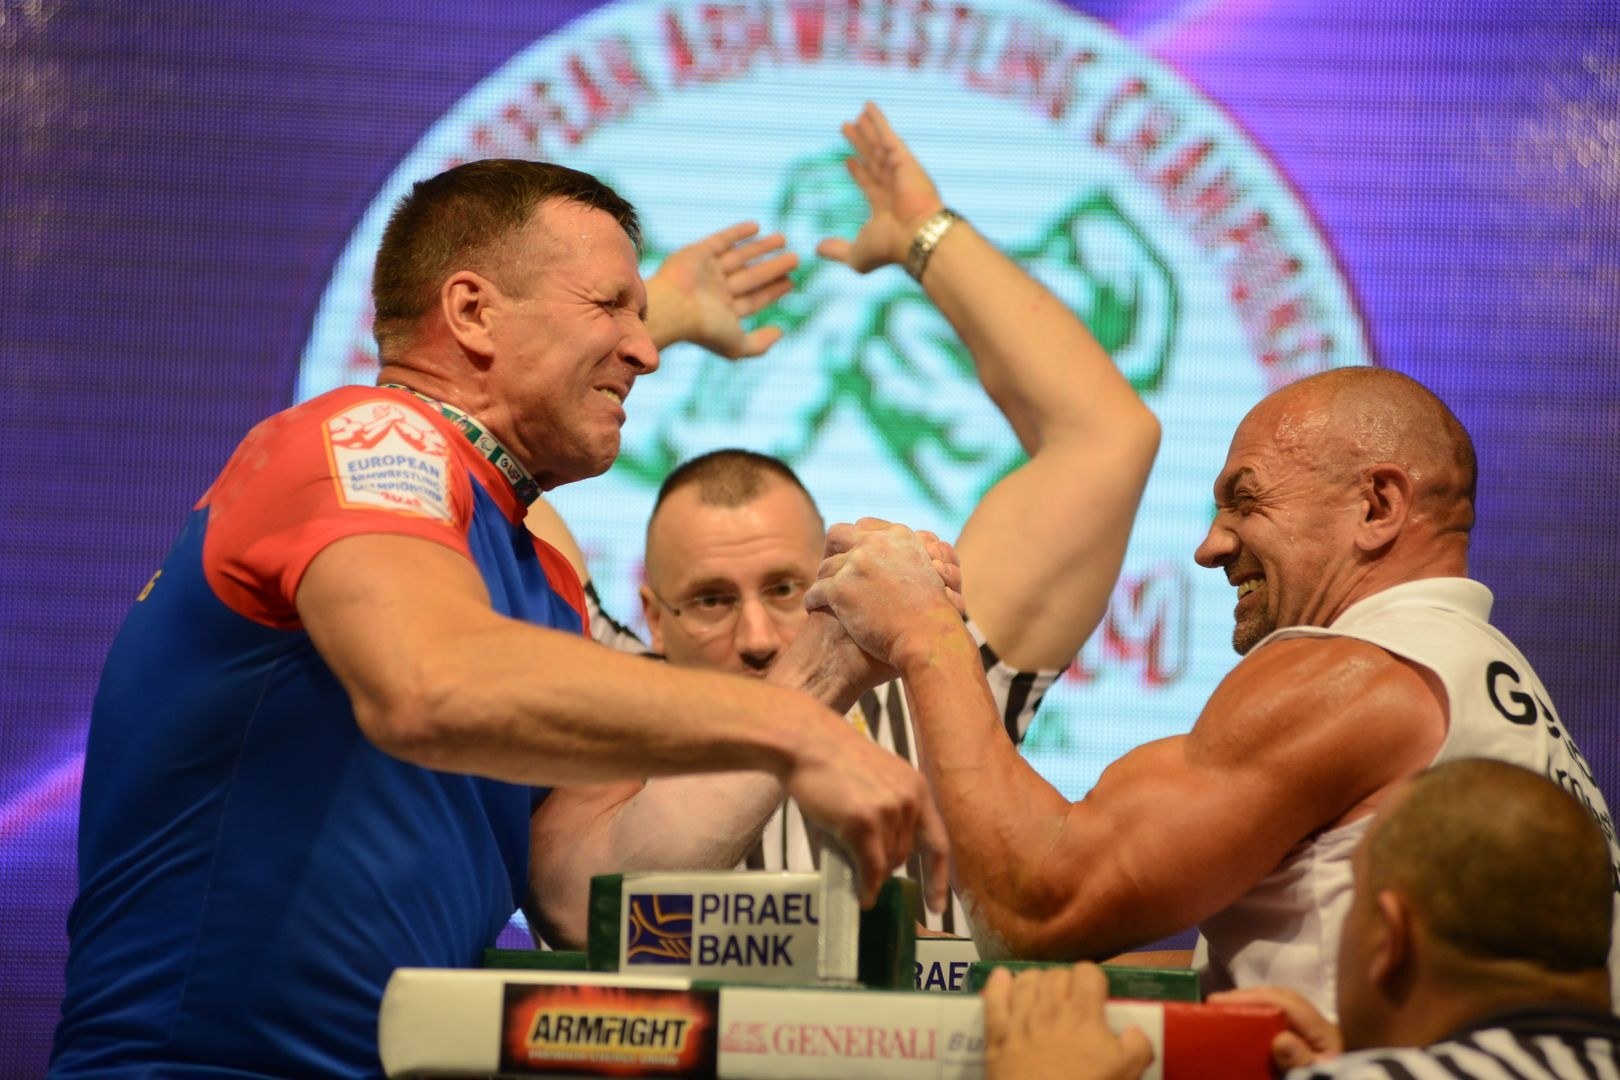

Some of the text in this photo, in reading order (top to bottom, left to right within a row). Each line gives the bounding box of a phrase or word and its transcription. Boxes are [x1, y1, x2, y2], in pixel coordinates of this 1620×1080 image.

[1091, 76, 1338, 392] CHAMPIONS
[347, 454, 441, 478] EUROPEAN
[350, 469, 441, 493] ARMWRESTLING
[700, 893, 818, 925] PIRAEU
[698, 935, 794, 967] BANK
[913, 961, 969, 992] RAE
[531, 1014, 687, 1049] ARMFIGHT
[772, 1022, 937, 1060] GENERALI
